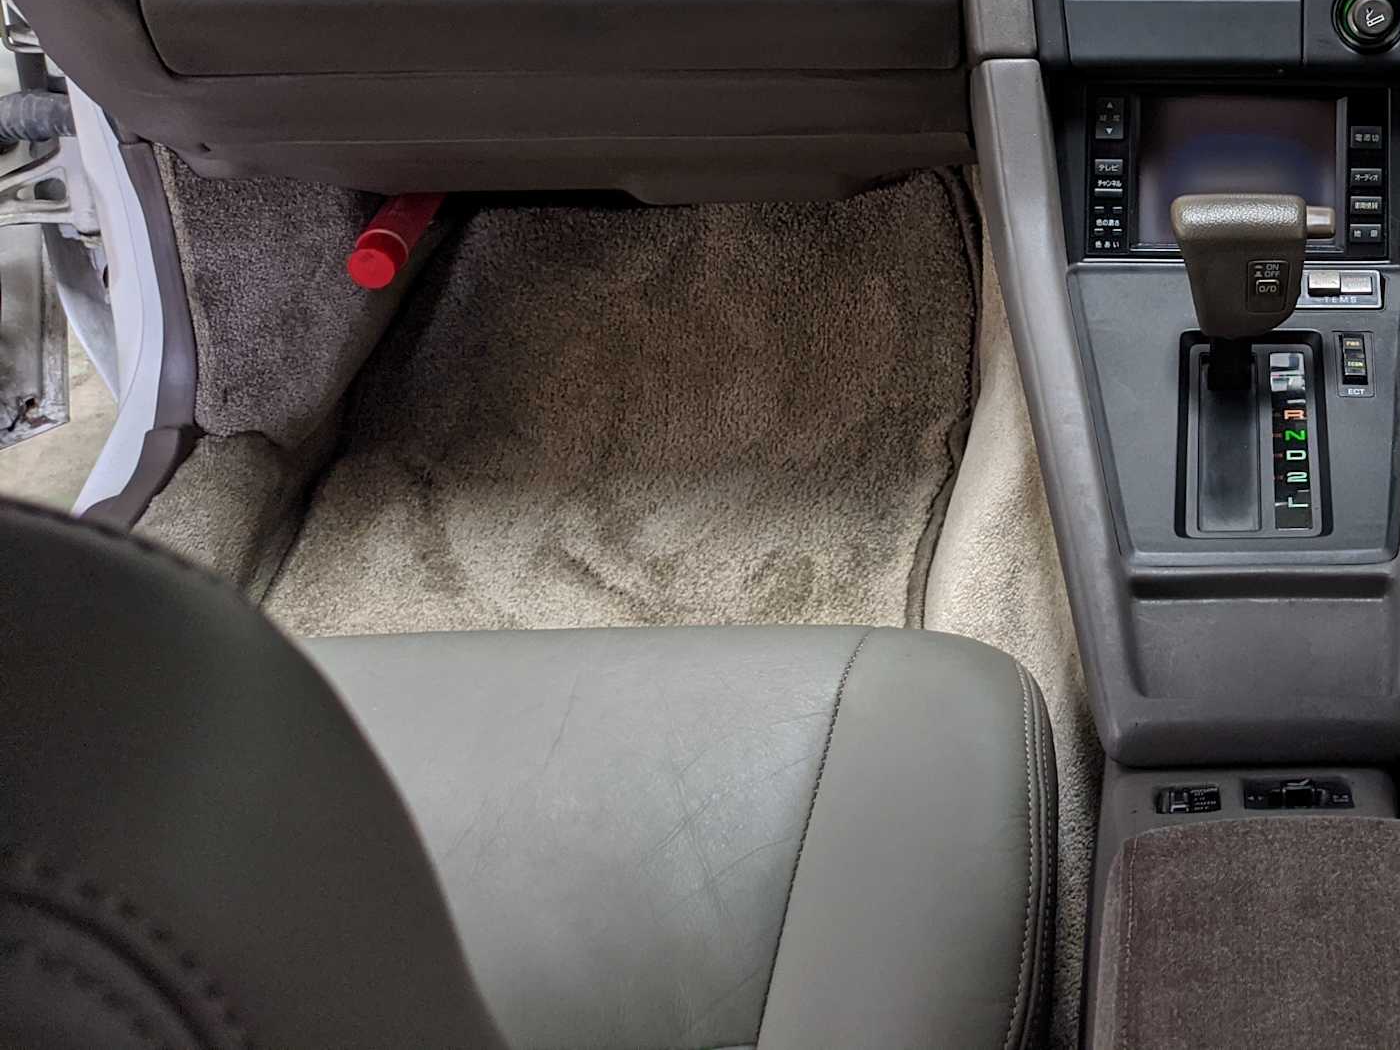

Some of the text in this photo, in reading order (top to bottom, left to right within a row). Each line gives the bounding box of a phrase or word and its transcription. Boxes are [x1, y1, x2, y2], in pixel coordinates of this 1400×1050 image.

[1098, 164, 1119, 172] テレビ
[1354, 174, 1379, 182] オーディオ
[1097, 179, 1122, 188] チャンネル
[1095, 240, 1120, 249] 色あい
[1266, 263, 1280, 271] ON
[1264, 270, 1281, 278] OFF
[1258, 285, 1277, 293] O/D
[1324, 296, 1358, 304] TEMS
[1283, 409, 1306, 420] R
[1285, 430, 1306, 440] N
[1285, 449, 1307, 461] D
[1286, 471, 1308, 483] 2
[1287, 496, 1309, 508] L
